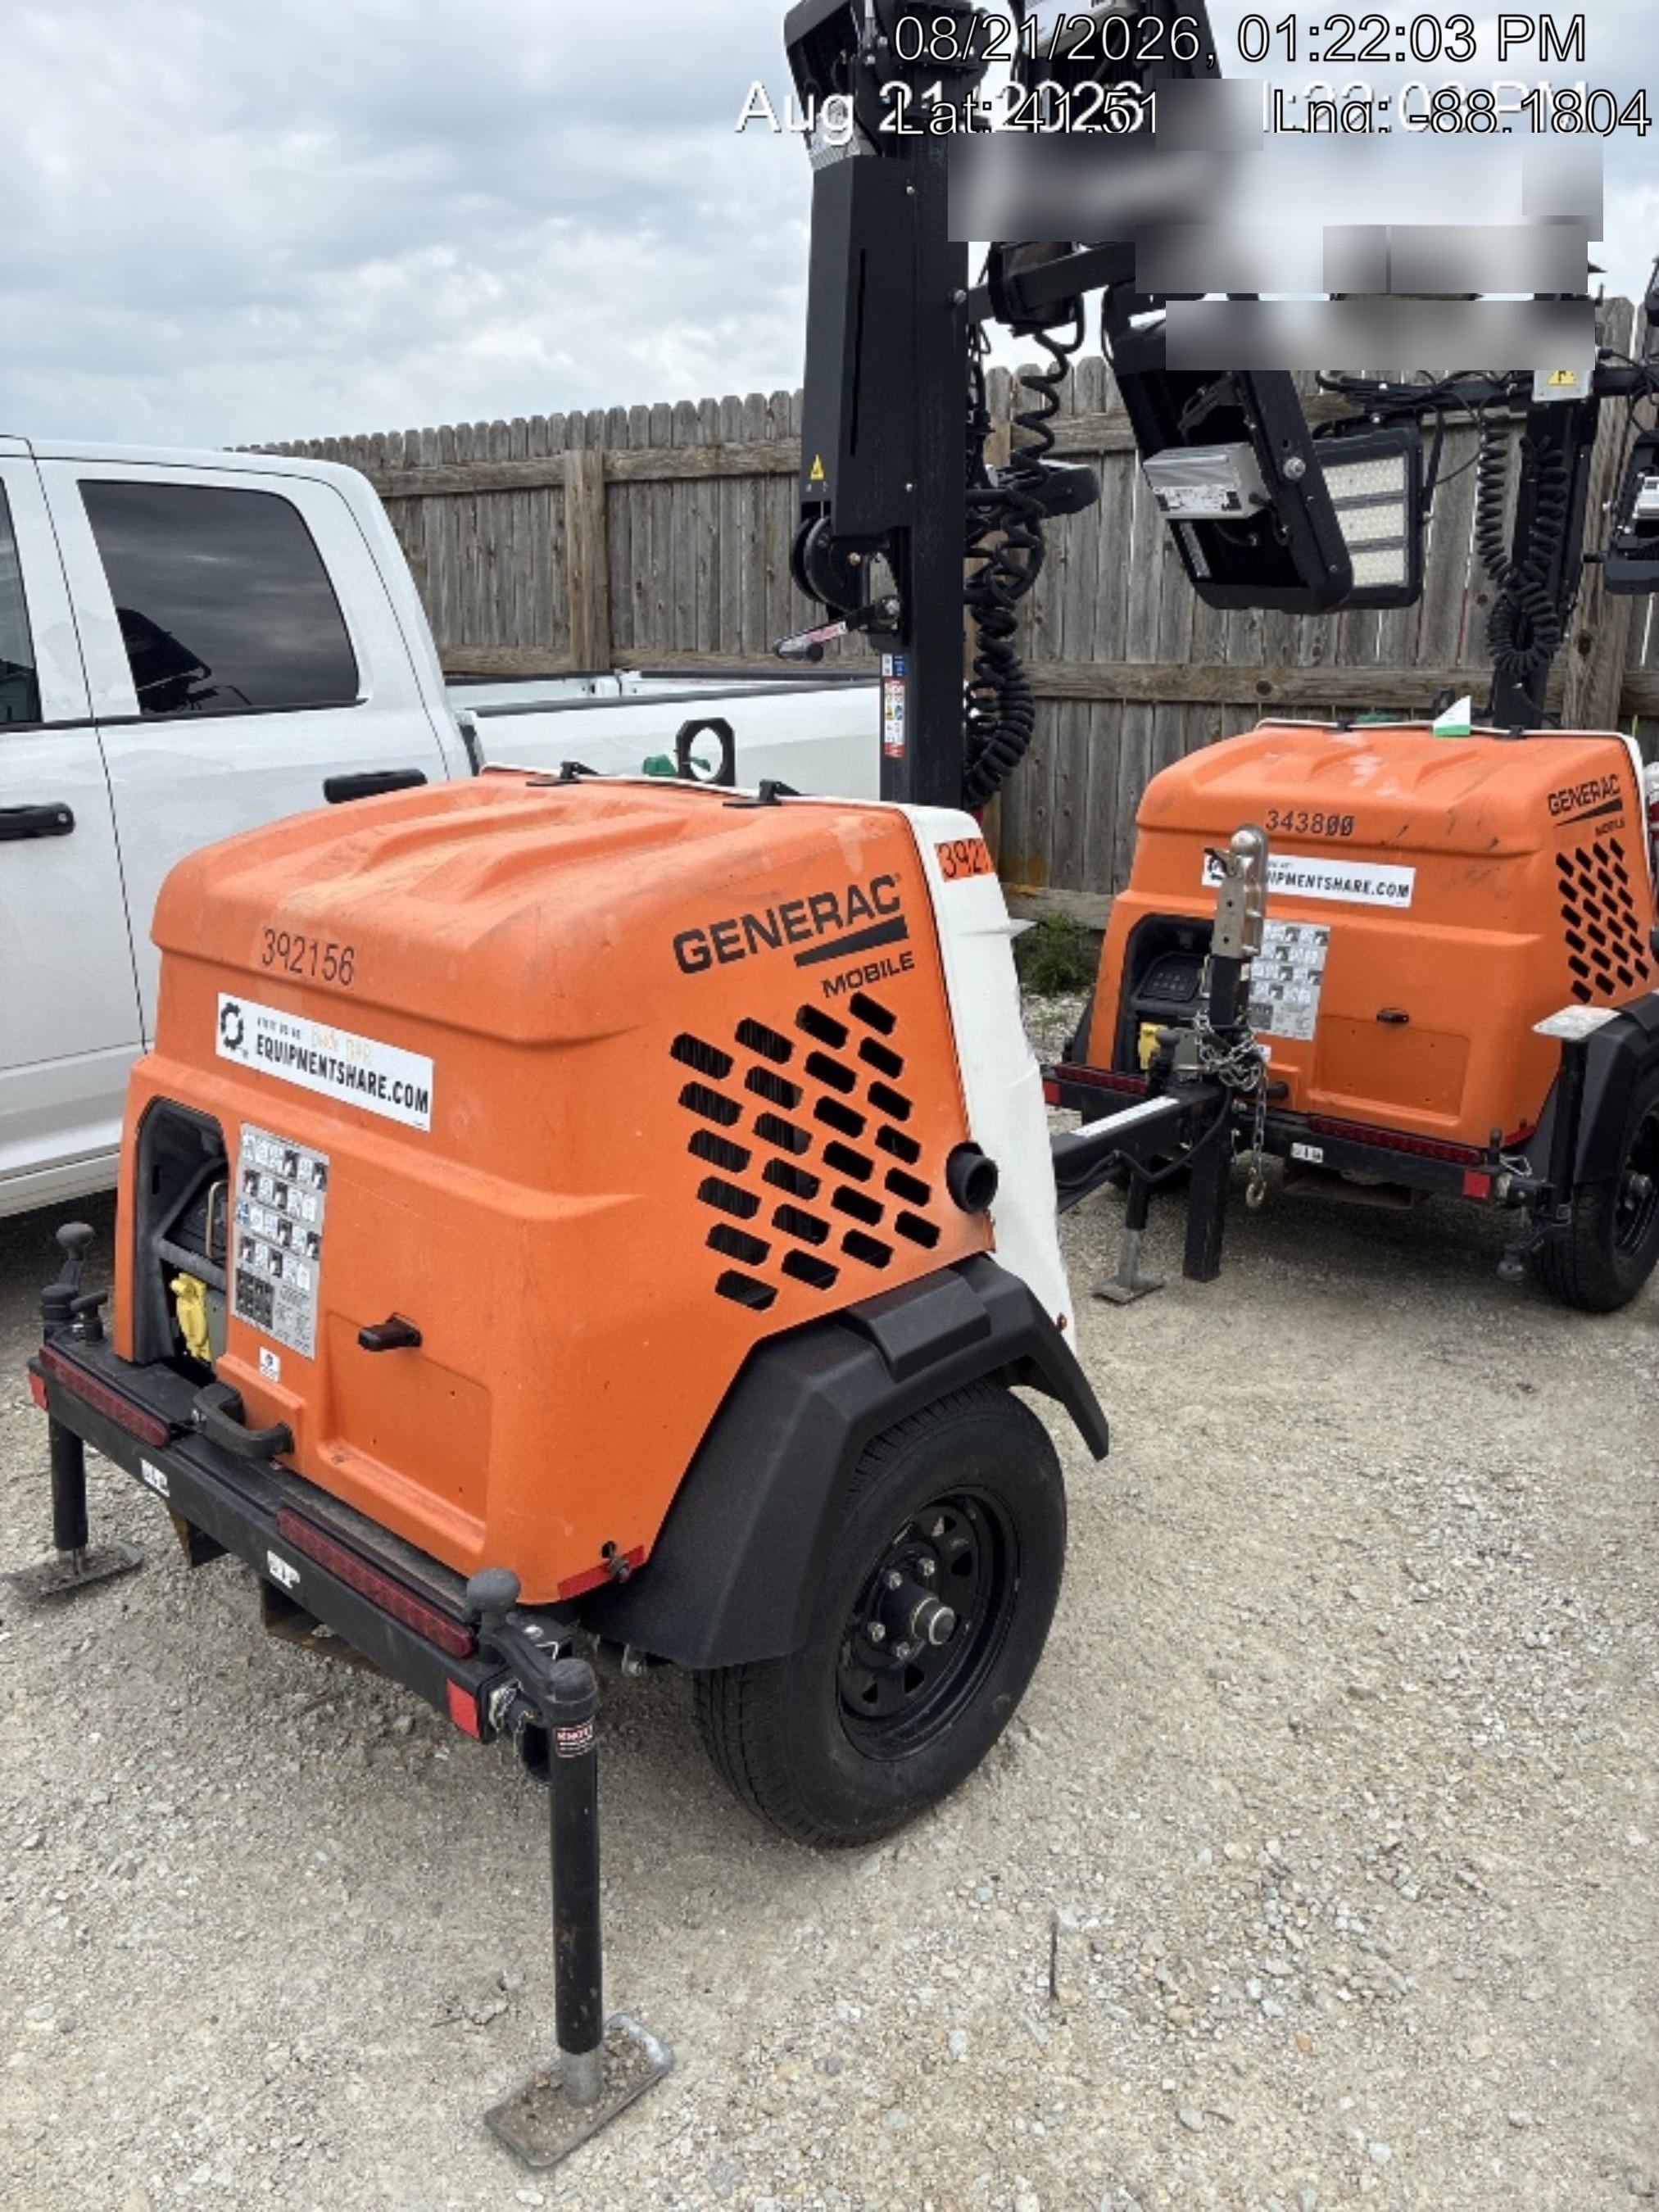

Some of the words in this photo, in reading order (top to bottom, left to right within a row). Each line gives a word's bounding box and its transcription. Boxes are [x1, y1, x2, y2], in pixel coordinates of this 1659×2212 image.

[1548, 773, 1620, 816] GENERAC
[1266, 809, 1355, 836] 343800
[673, 874, 901, 974] GENERAC
[262, 927, 355, 986] 392156
[822, 950, 915, 999] MOBILE
[256, 1033, 429, 1114] EQUIPMENTSHARE.COM
